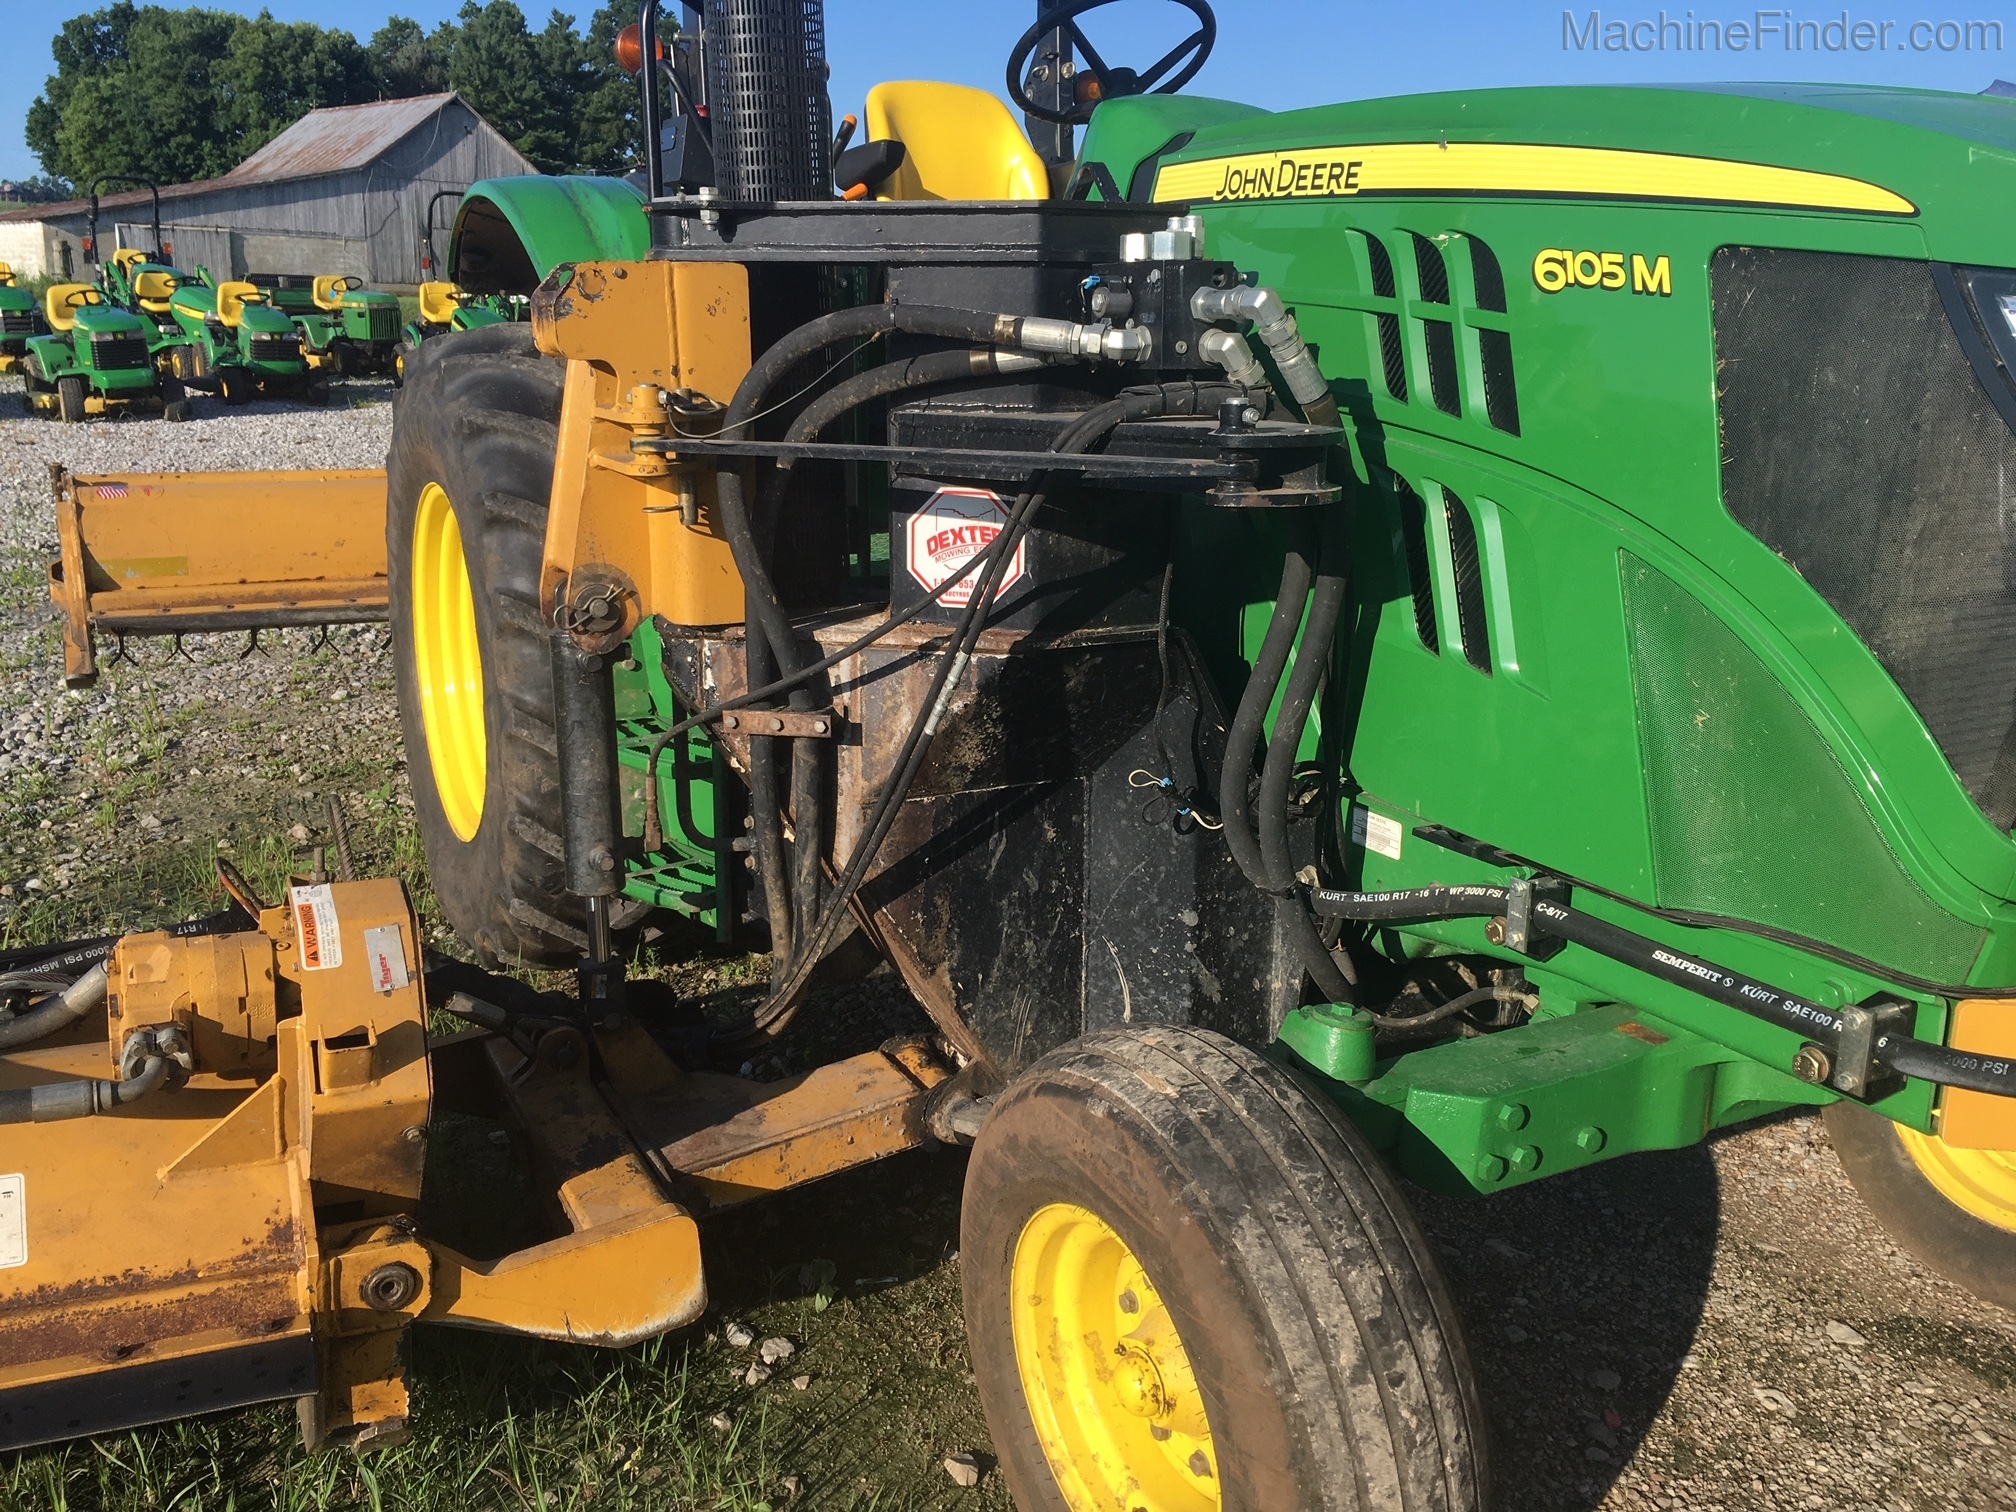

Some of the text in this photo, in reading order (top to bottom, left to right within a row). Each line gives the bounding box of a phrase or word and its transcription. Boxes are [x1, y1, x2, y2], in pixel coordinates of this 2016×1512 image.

[1216, 159, 1364, 197] JOHN DEERE
[935, 546, 971, 564] MOWING
[1319, 891, 1348, 902] KURT
[1353, 892, 1391, 903] SAE100
[1392, 890, 1410, 900] R17
[1464, 886, 1487, 897] 3000
[1486, 887, 1504, 899] PSI
[1535, 901, 1569, 921] C-8/17
[176, 924, 198, 936] R17
[300, 904, 318, 949] WARNING
[27, 960, 60, 973] MSH
[64, 953, 83, 966] PSI
[1651, 949, 1723, 984] SEMPERIT
[1740, 983, 1780, 1005] KURT
[1782, 1000, 1833, 1027] SAE100
[1981, 1060, 2010, 1076] PSI
